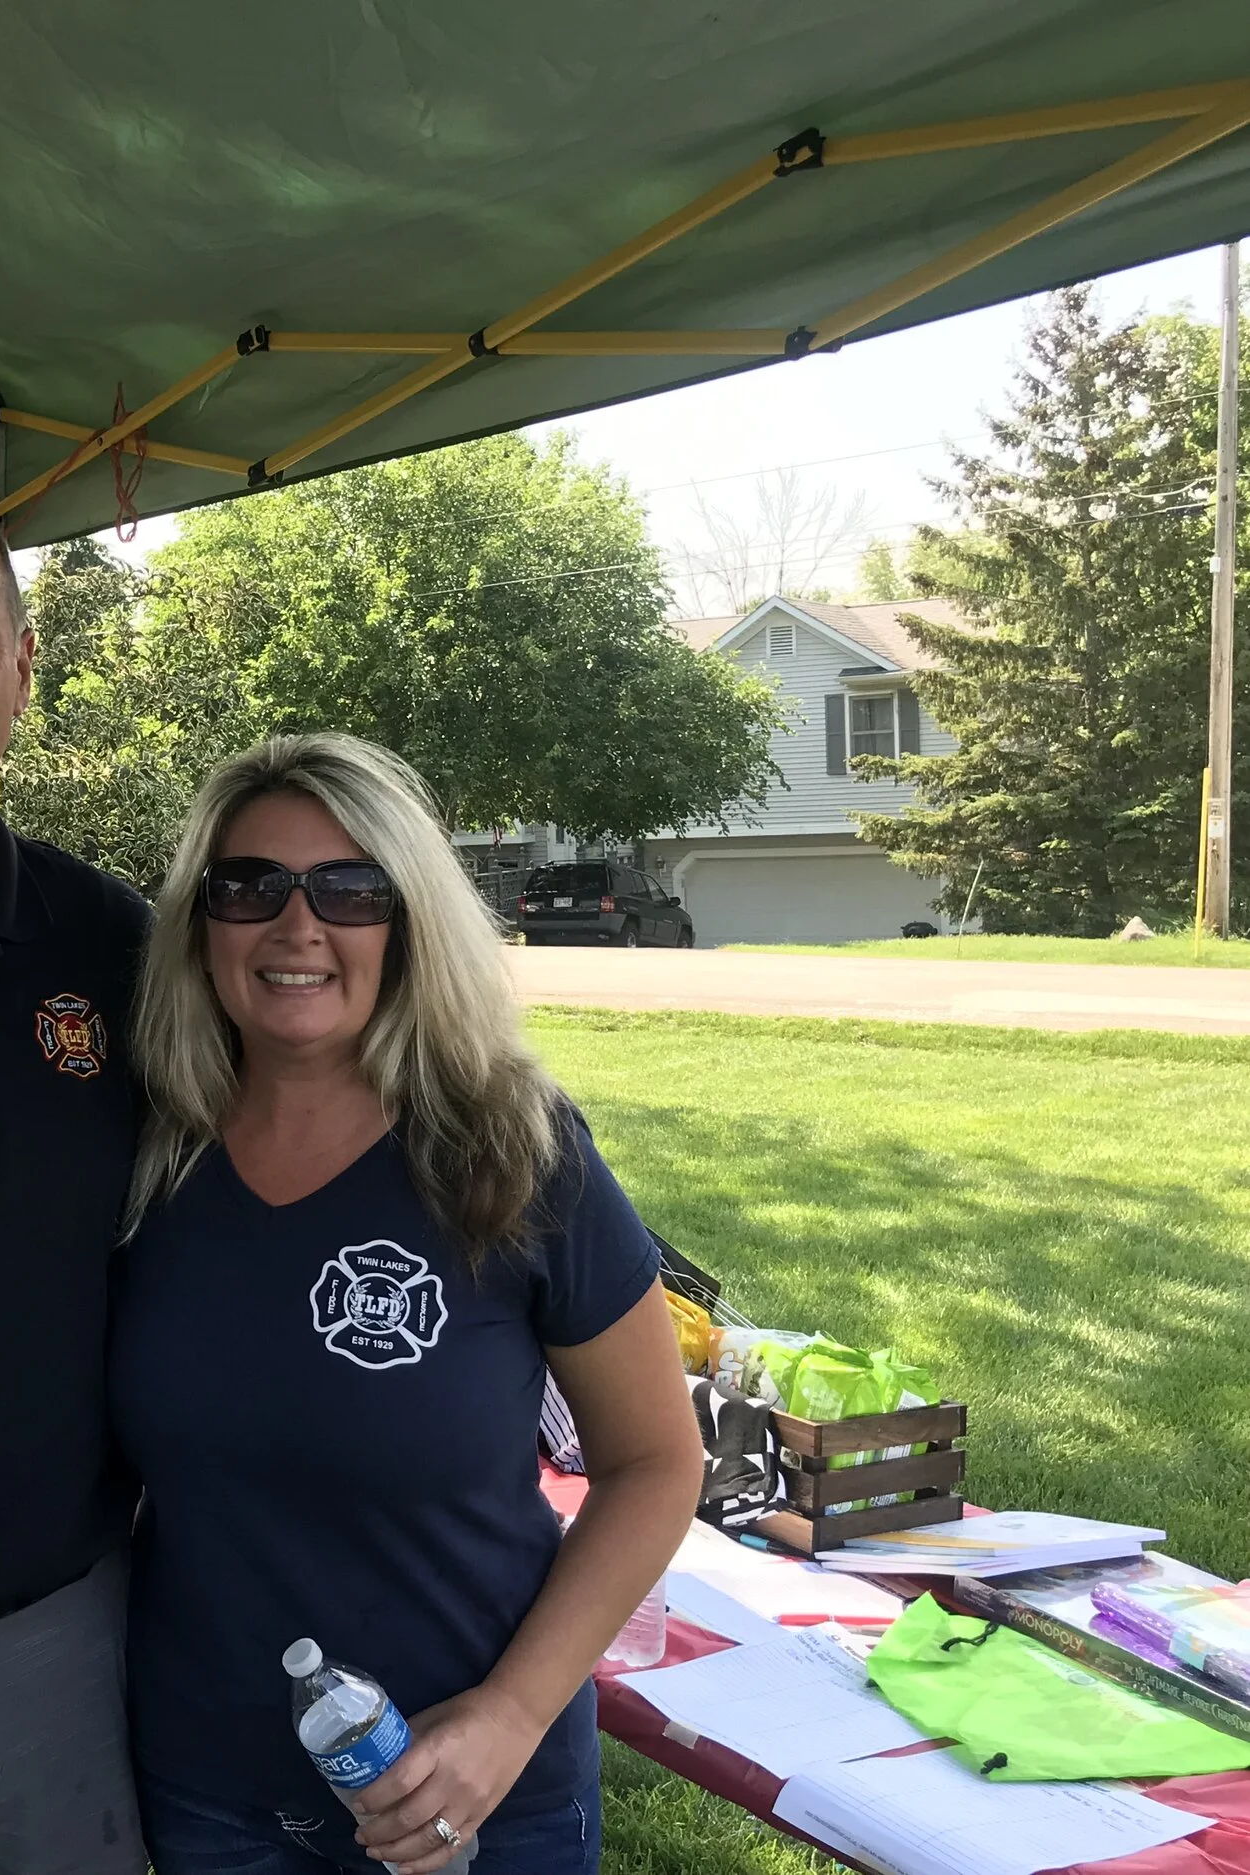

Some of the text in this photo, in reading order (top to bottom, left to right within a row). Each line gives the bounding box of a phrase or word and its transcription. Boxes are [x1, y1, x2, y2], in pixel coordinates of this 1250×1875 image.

[51, 1002, 86, 1010] TWIN LAKES
[43, 1021, 54, 1050] FIRE
[67, 1060, 80, 1068] EST
[356, 1256, 410, 1272] TWIN LAKES
[327, 1279, 339, 1314] FIRE
[354, 1293, 400, 1318] TLFD
[419, 1290, 428, 1332] RESCUE
[351, 1335, 394, 1350] EST 1929
[1014, 1611, 1083, 1652] MONOPOLY
[1135, 1666, 1182, 1700] NIGHTMARE
[1182, 1691, 1211, 1714] BEFORE
